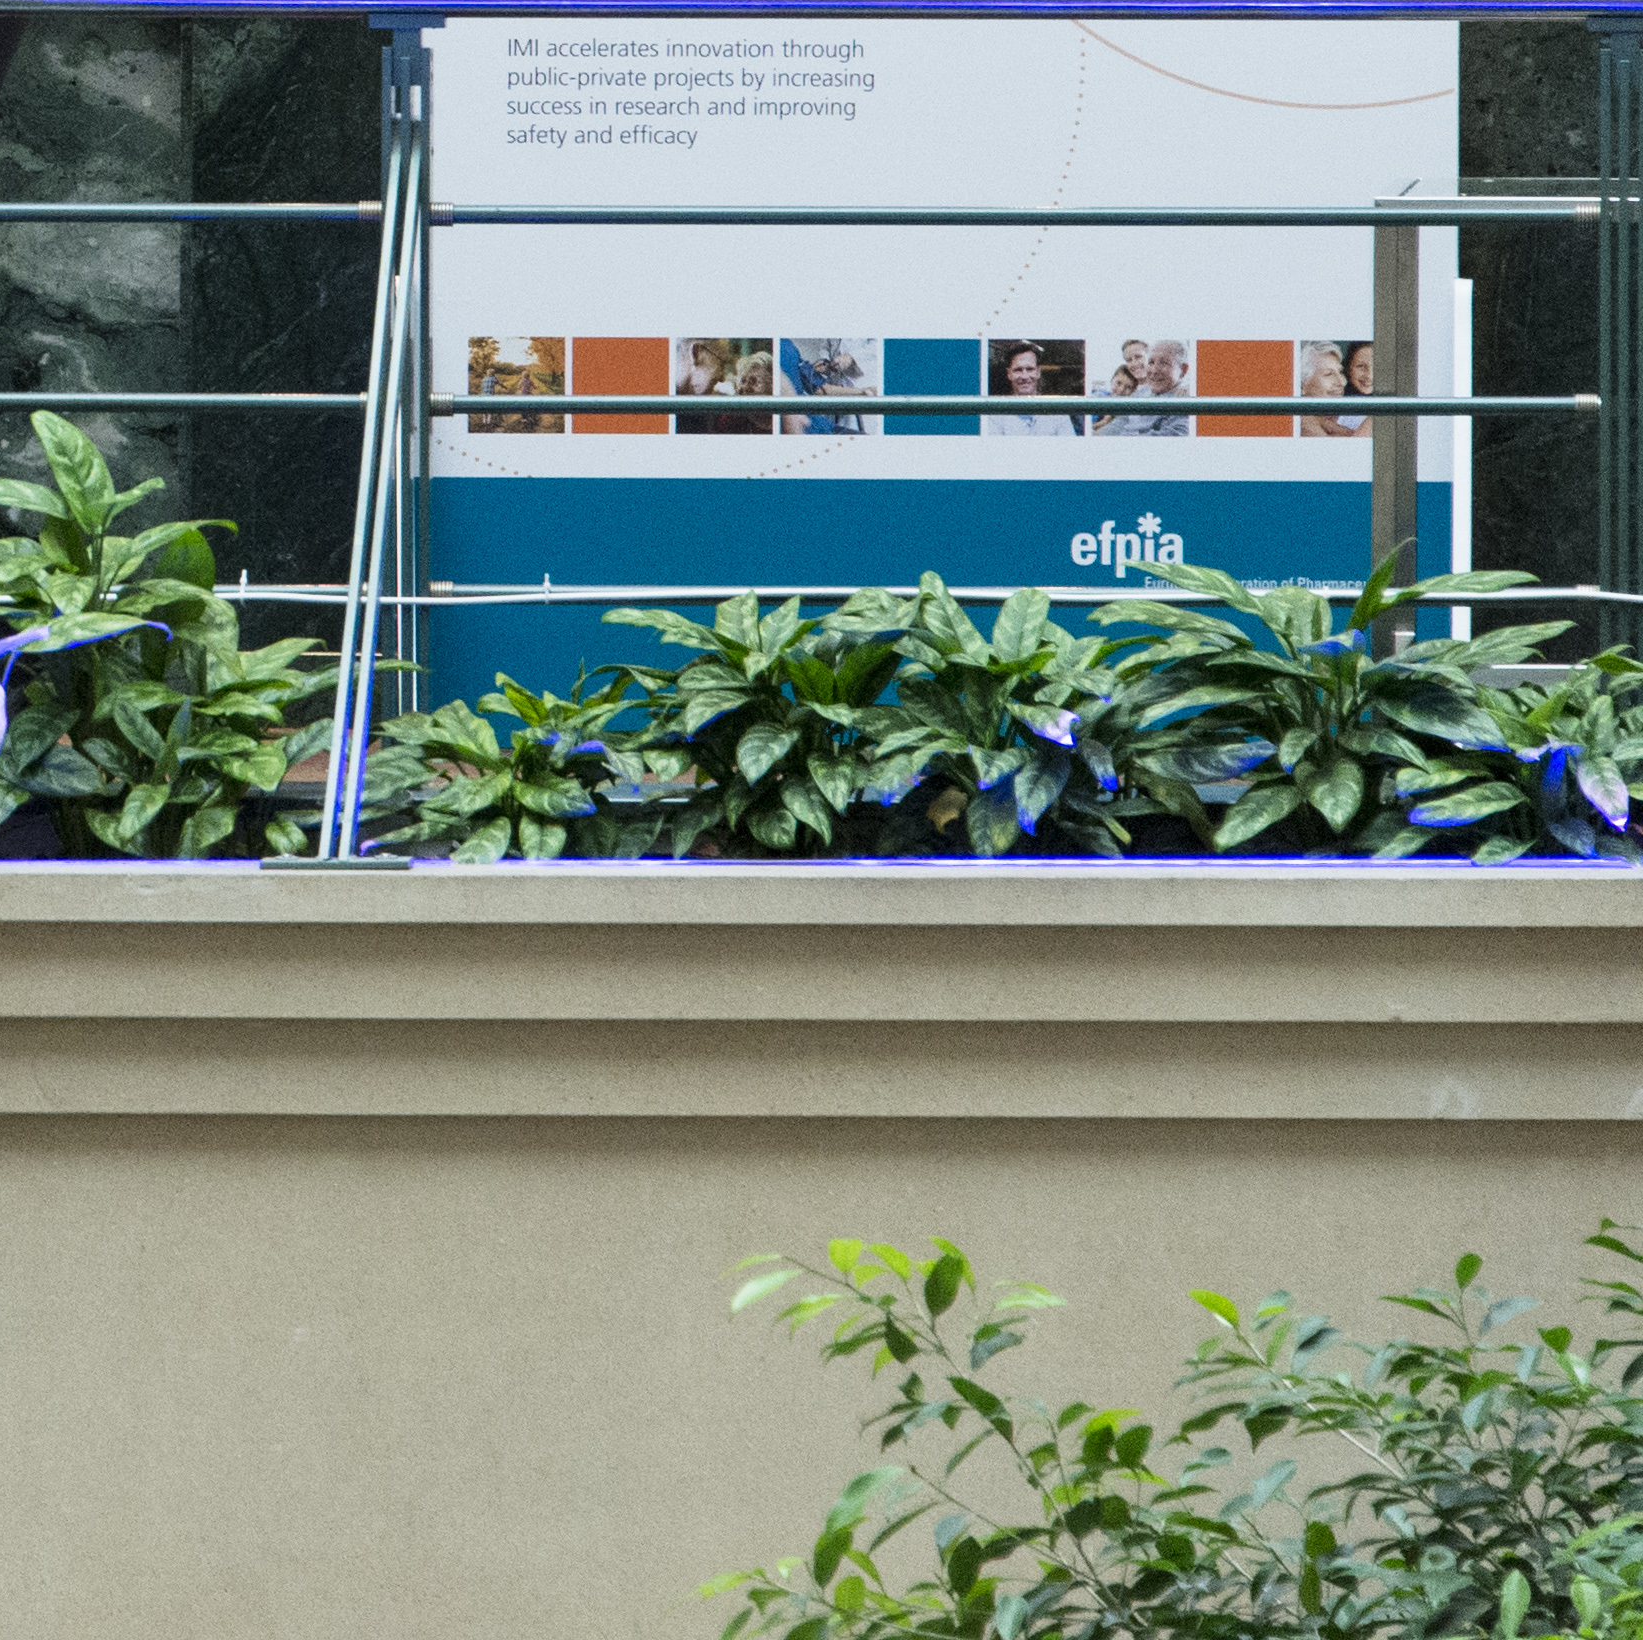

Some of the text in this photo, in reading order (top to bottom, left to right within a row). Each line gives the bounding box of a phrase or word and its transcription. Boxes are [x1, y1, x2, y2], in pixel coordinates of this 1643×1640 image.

[508, 37, 864, 63] IMI accelerates innovation through
[507, 66, 875, 93] public-private projects by increasing
[507, 96, 856, 122] success in research and improving
[507, 124, 698, 150] safety and efficacy
[1071, 513, 1184, 579] efpia
